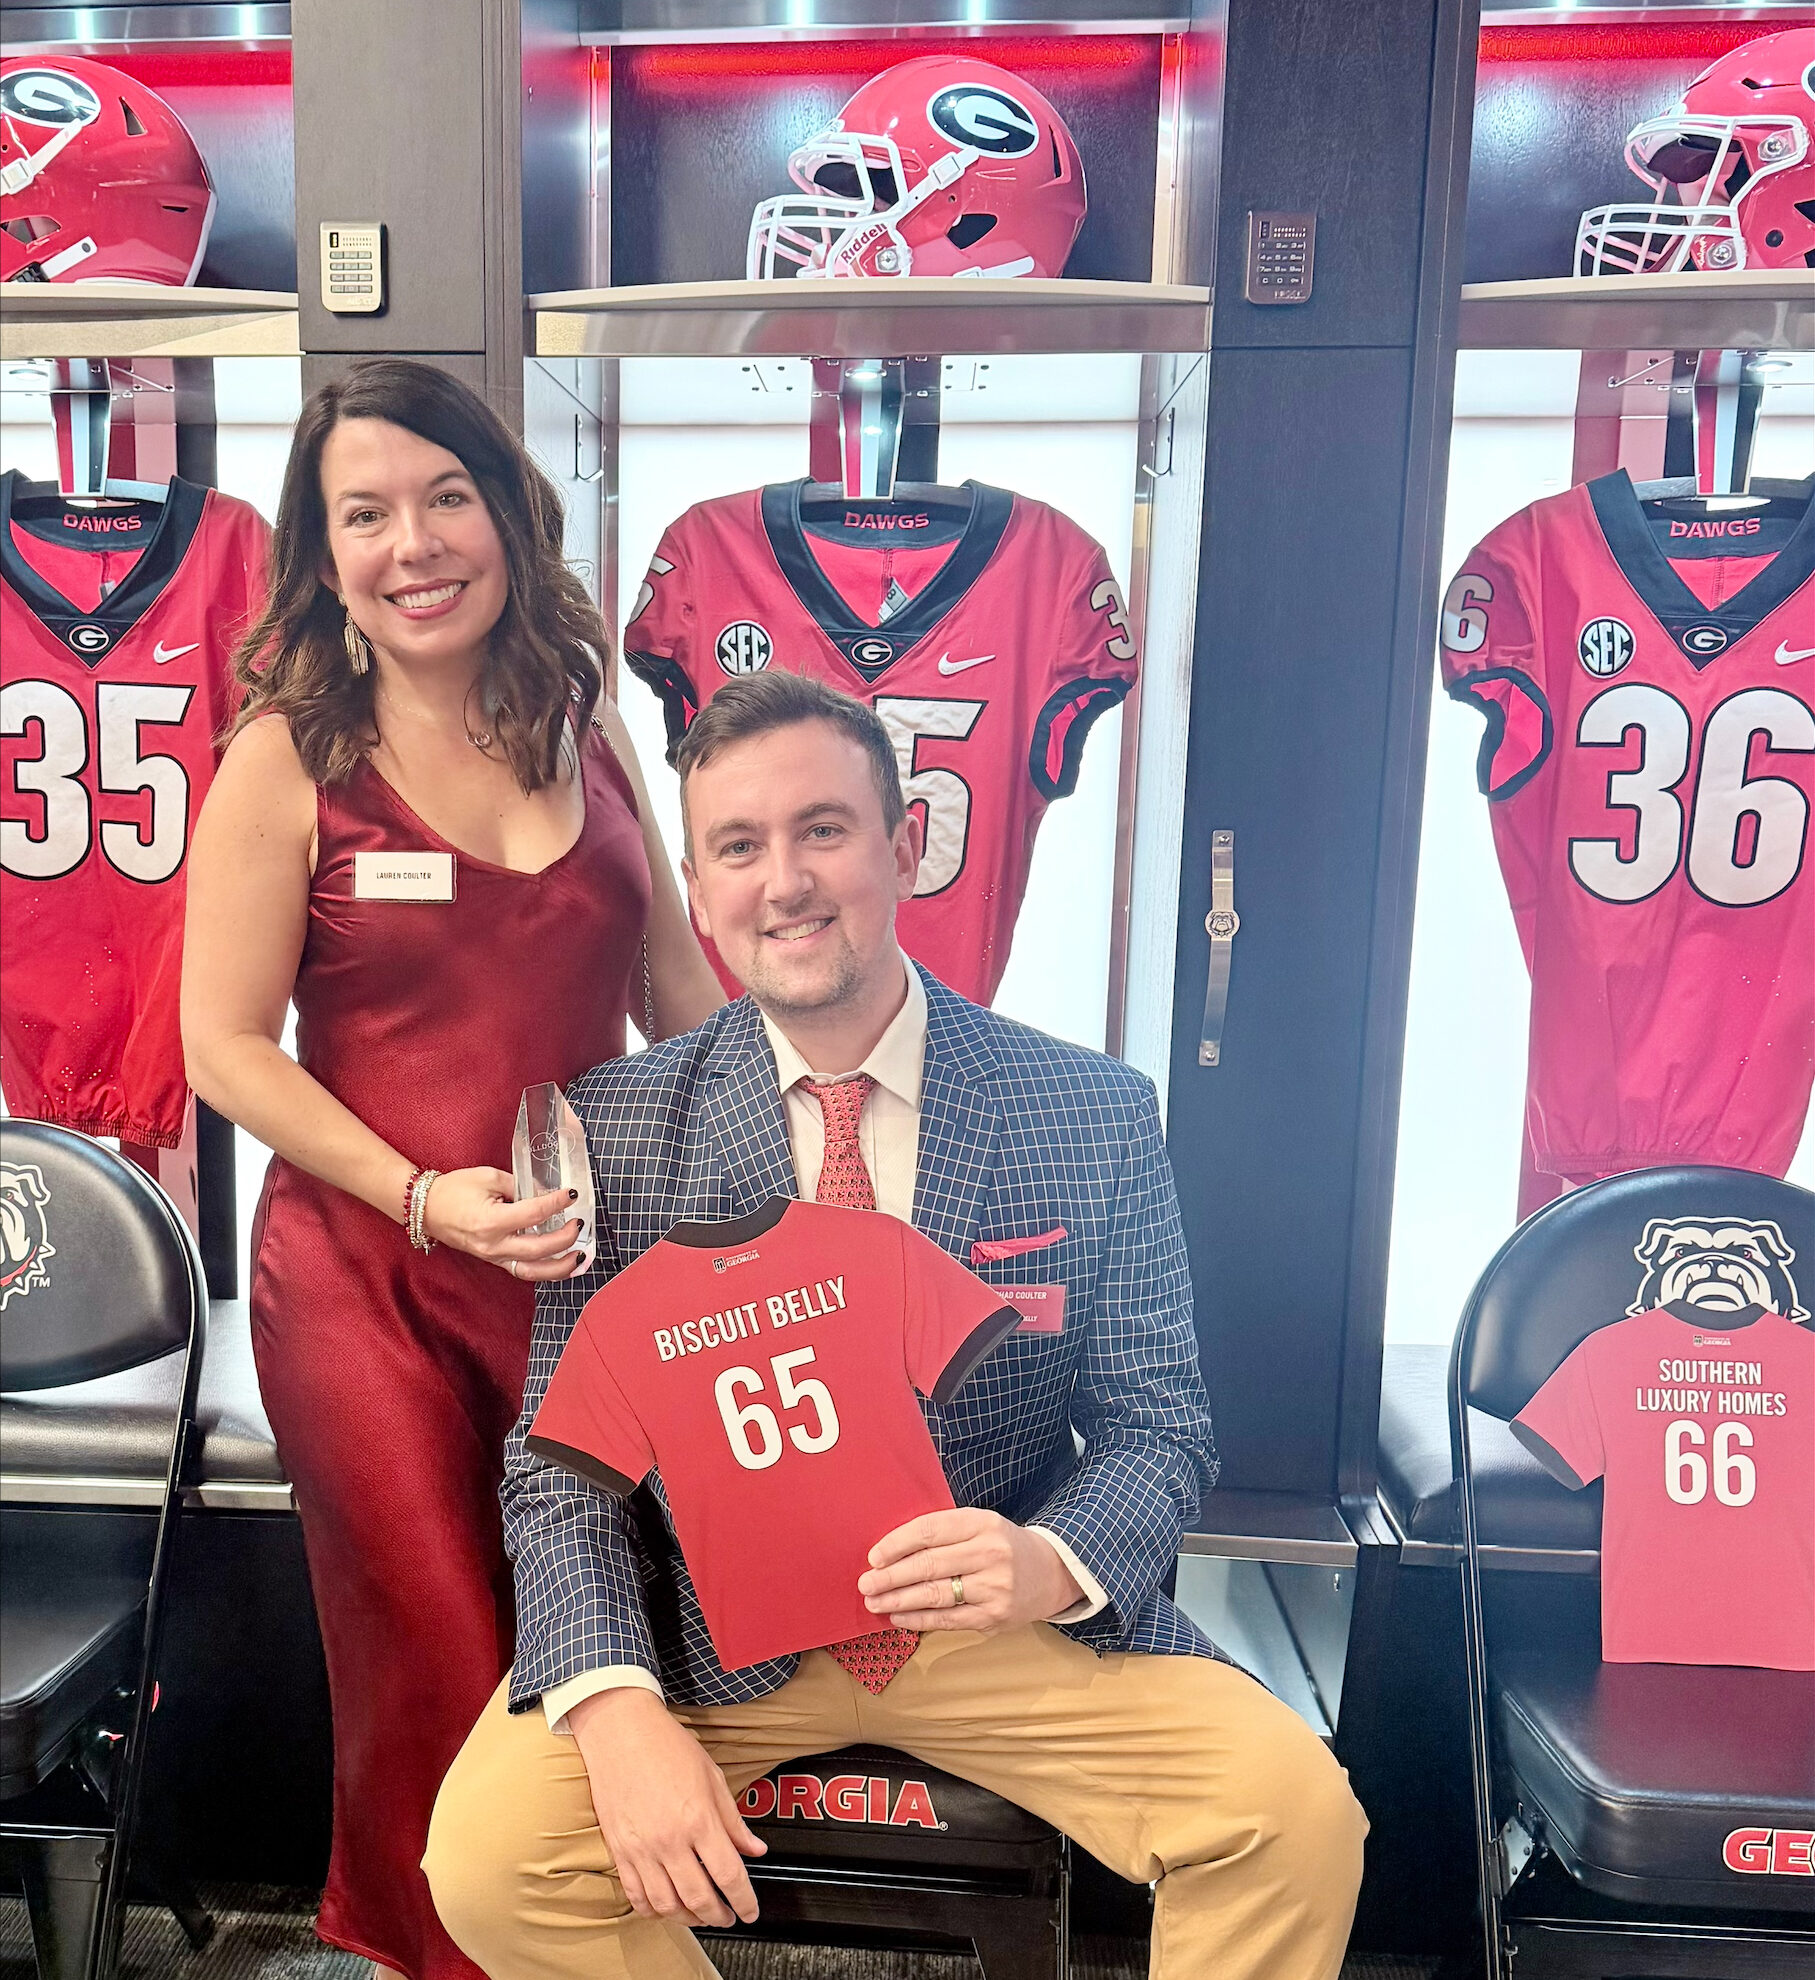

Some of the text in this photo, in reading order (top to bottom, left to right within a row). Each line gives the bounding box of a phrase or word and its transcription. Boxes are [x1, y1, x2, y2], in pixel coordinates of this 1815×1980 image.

[931, 86, 1037, 155] G
[62, 513, 142, 533] DAWGS
[844, 511, 931, 531] DAWGS
[1669, 517, 1761, 539] DAWGS
[718, 622, 771, 677] SEC
[1581, 620, 1633, 675] SEC
[0, 677, 197, 884] 35
[873, 695, 989, 899] 5
[1568, 681, 1815, 909] 36
[376, 872, 432, 880] LAUREN COULTER
[32, 1276, 51, 1288] TM
[1015, 1291, 1047, 1300] COULTER
[653, 1275, 848, 1362] BISCUIT BELLY
[1658, 1358, 1762, 1386] SOUTHERN
[713, 1344, 841, 1471] 65
[1635, 1387, 1787, 1417] LUXURY HOMES
[1663, 1418, 1757, 1508] 66
[735, 1774, 940, 1830] ORGIA
[1722, 1826, 1815, 1877] GE
